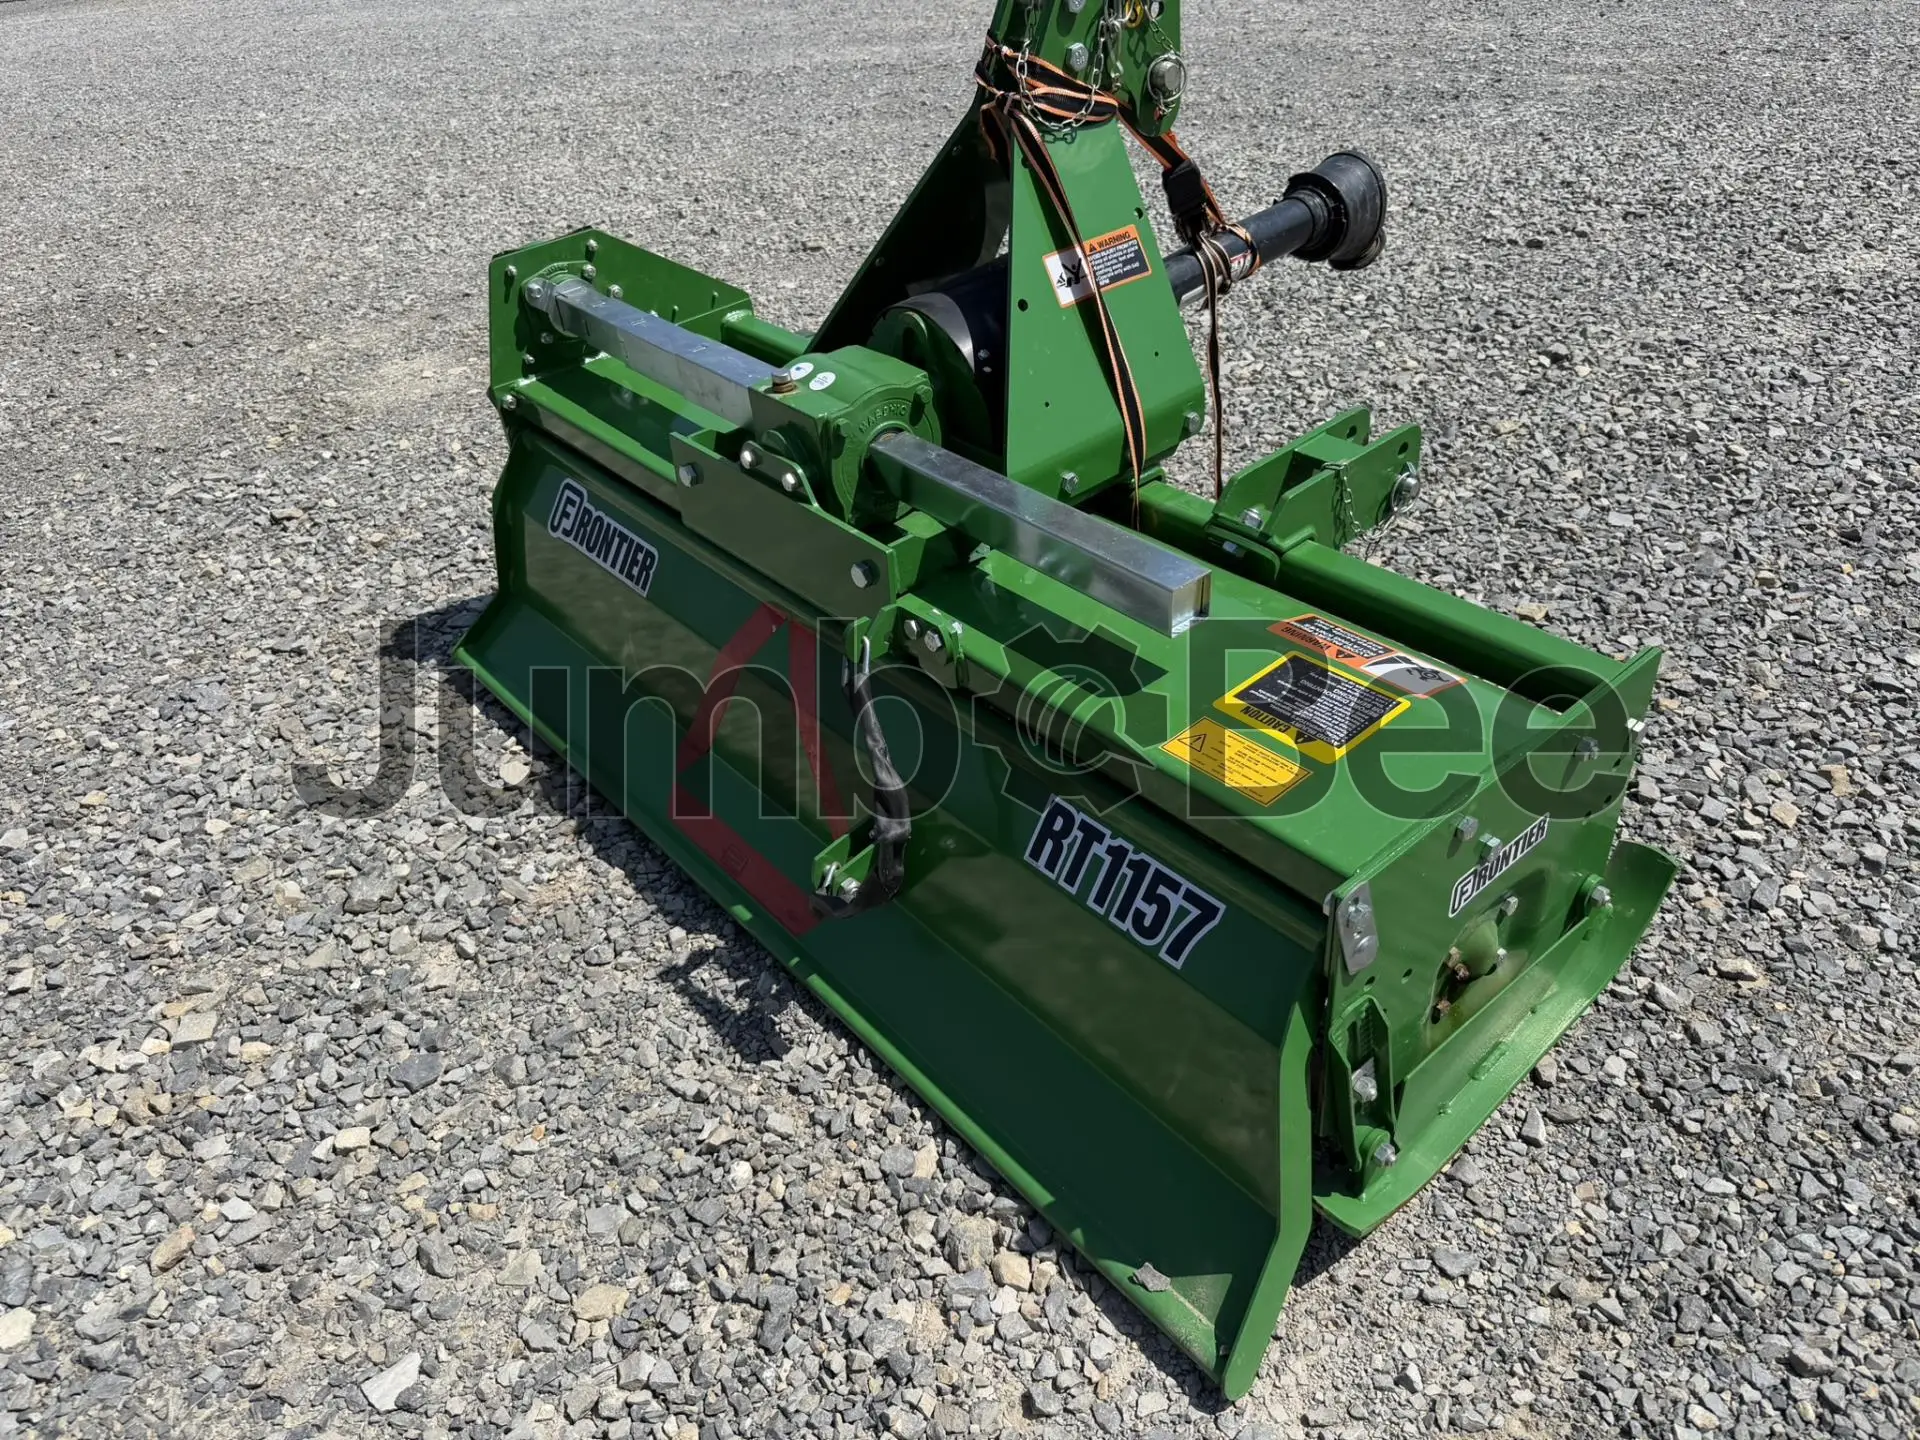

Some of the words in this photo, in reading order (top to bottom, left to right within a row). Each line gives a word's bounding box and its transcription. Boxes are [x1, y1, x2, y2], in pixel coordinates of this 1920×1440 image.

[1097, 231, 1131, 248] WARNING
[549, 480, 657, 593] FRONTIER
[1240, 706, 1293, 733] CAUTION
[1025, 795, 1226, 970] RT1157
[1449, 813, 1550, 917] FRONTIER
